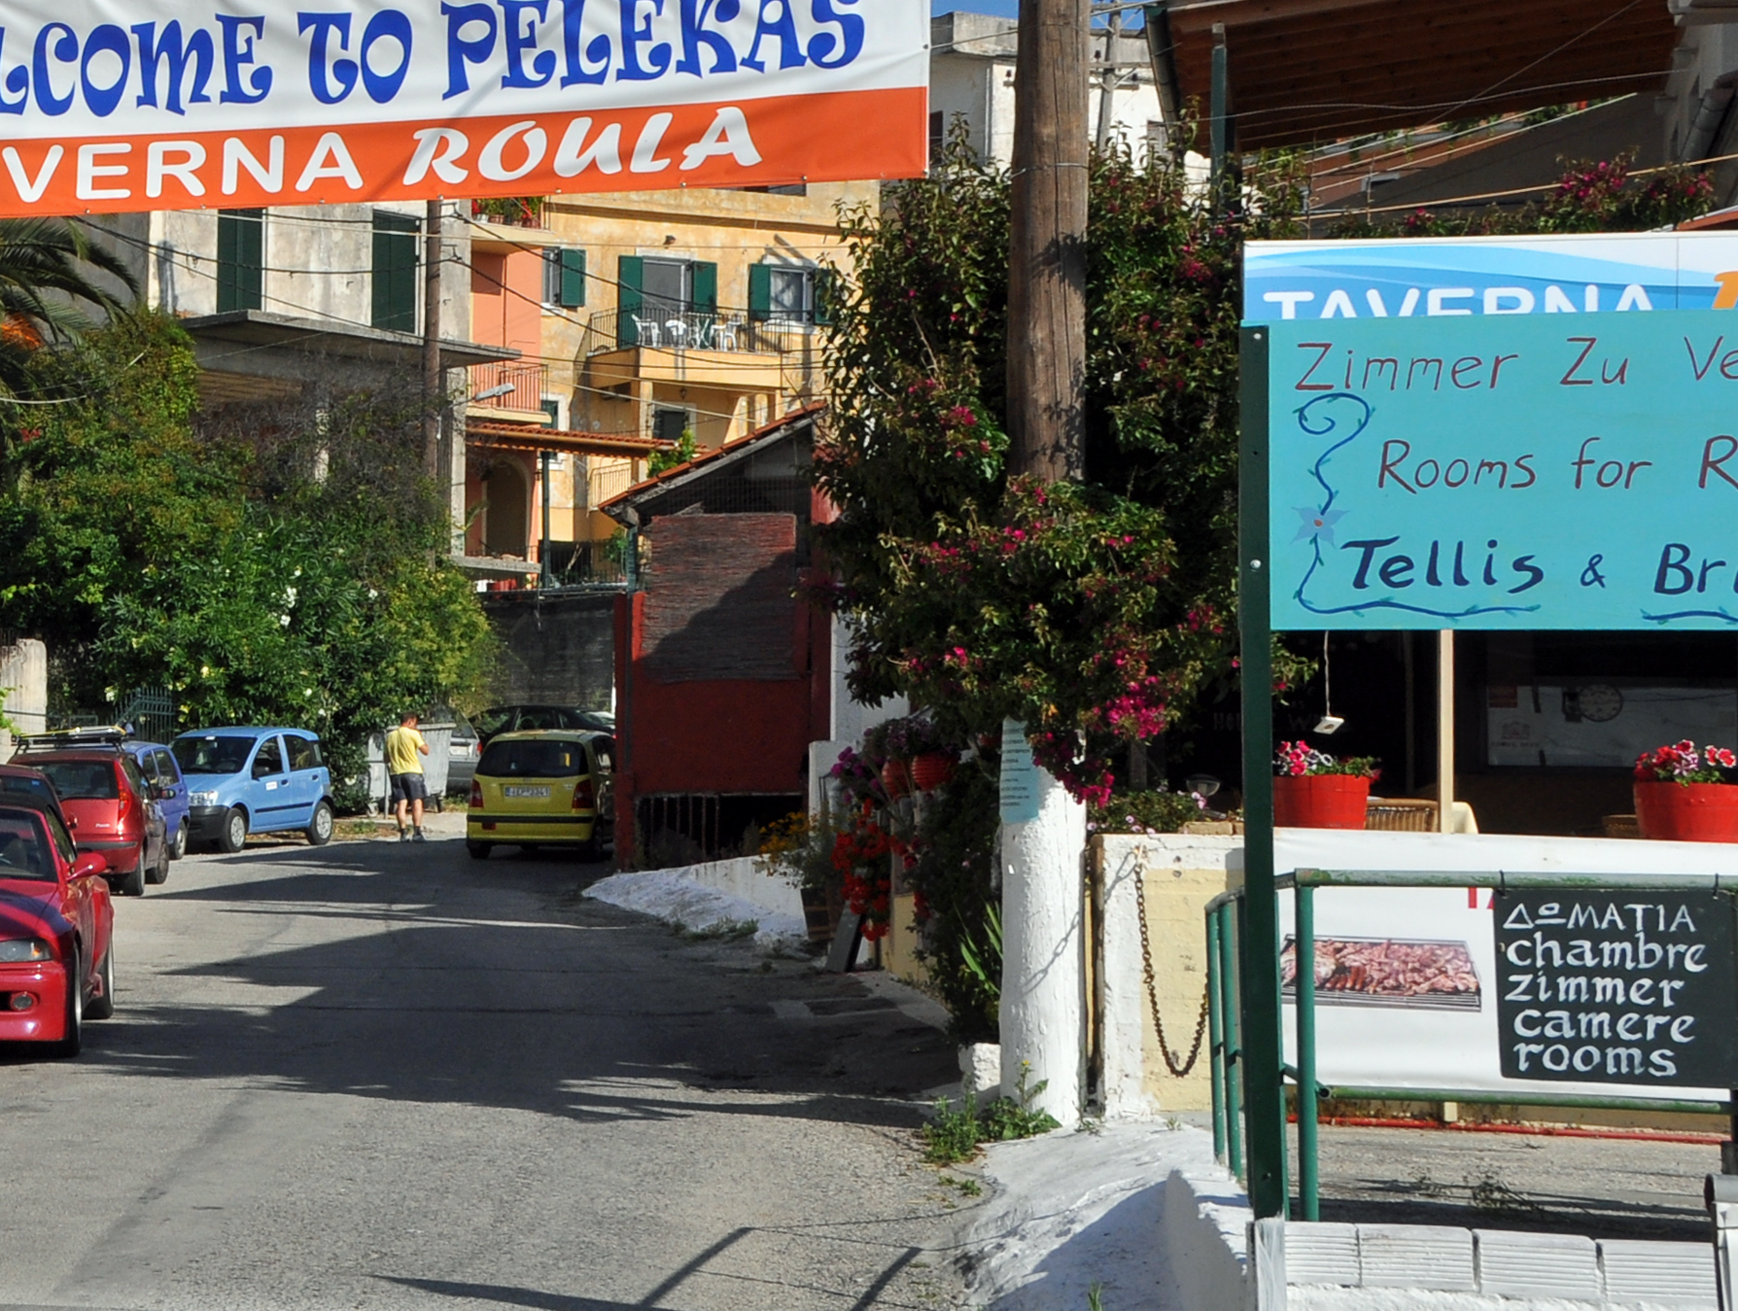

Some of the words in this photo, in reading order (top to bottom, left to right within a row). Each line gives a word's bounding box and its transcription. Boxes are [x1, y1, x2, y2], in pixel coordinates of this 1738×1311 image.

[297, 8, 413, 104] TO
[402, 106, 764, 184] ROULA
[1294, 341, 1520, 391] Zimmer
[1559, 337, 1629, 385] Zu
[1377, 439, 1538, 494] Rooms
[1570, 437, 1653, 489] for
[1340, 536, 1544, 594] Tellis
[1579, 554, 1607, 589] &
[1506, 931, 1708, 972] chambre
[1504, 971, 1684, 1007] zimmer
[1513, 1010, 1695, 1043] camere
[1512, 1041, 1677, 1078] rooms
